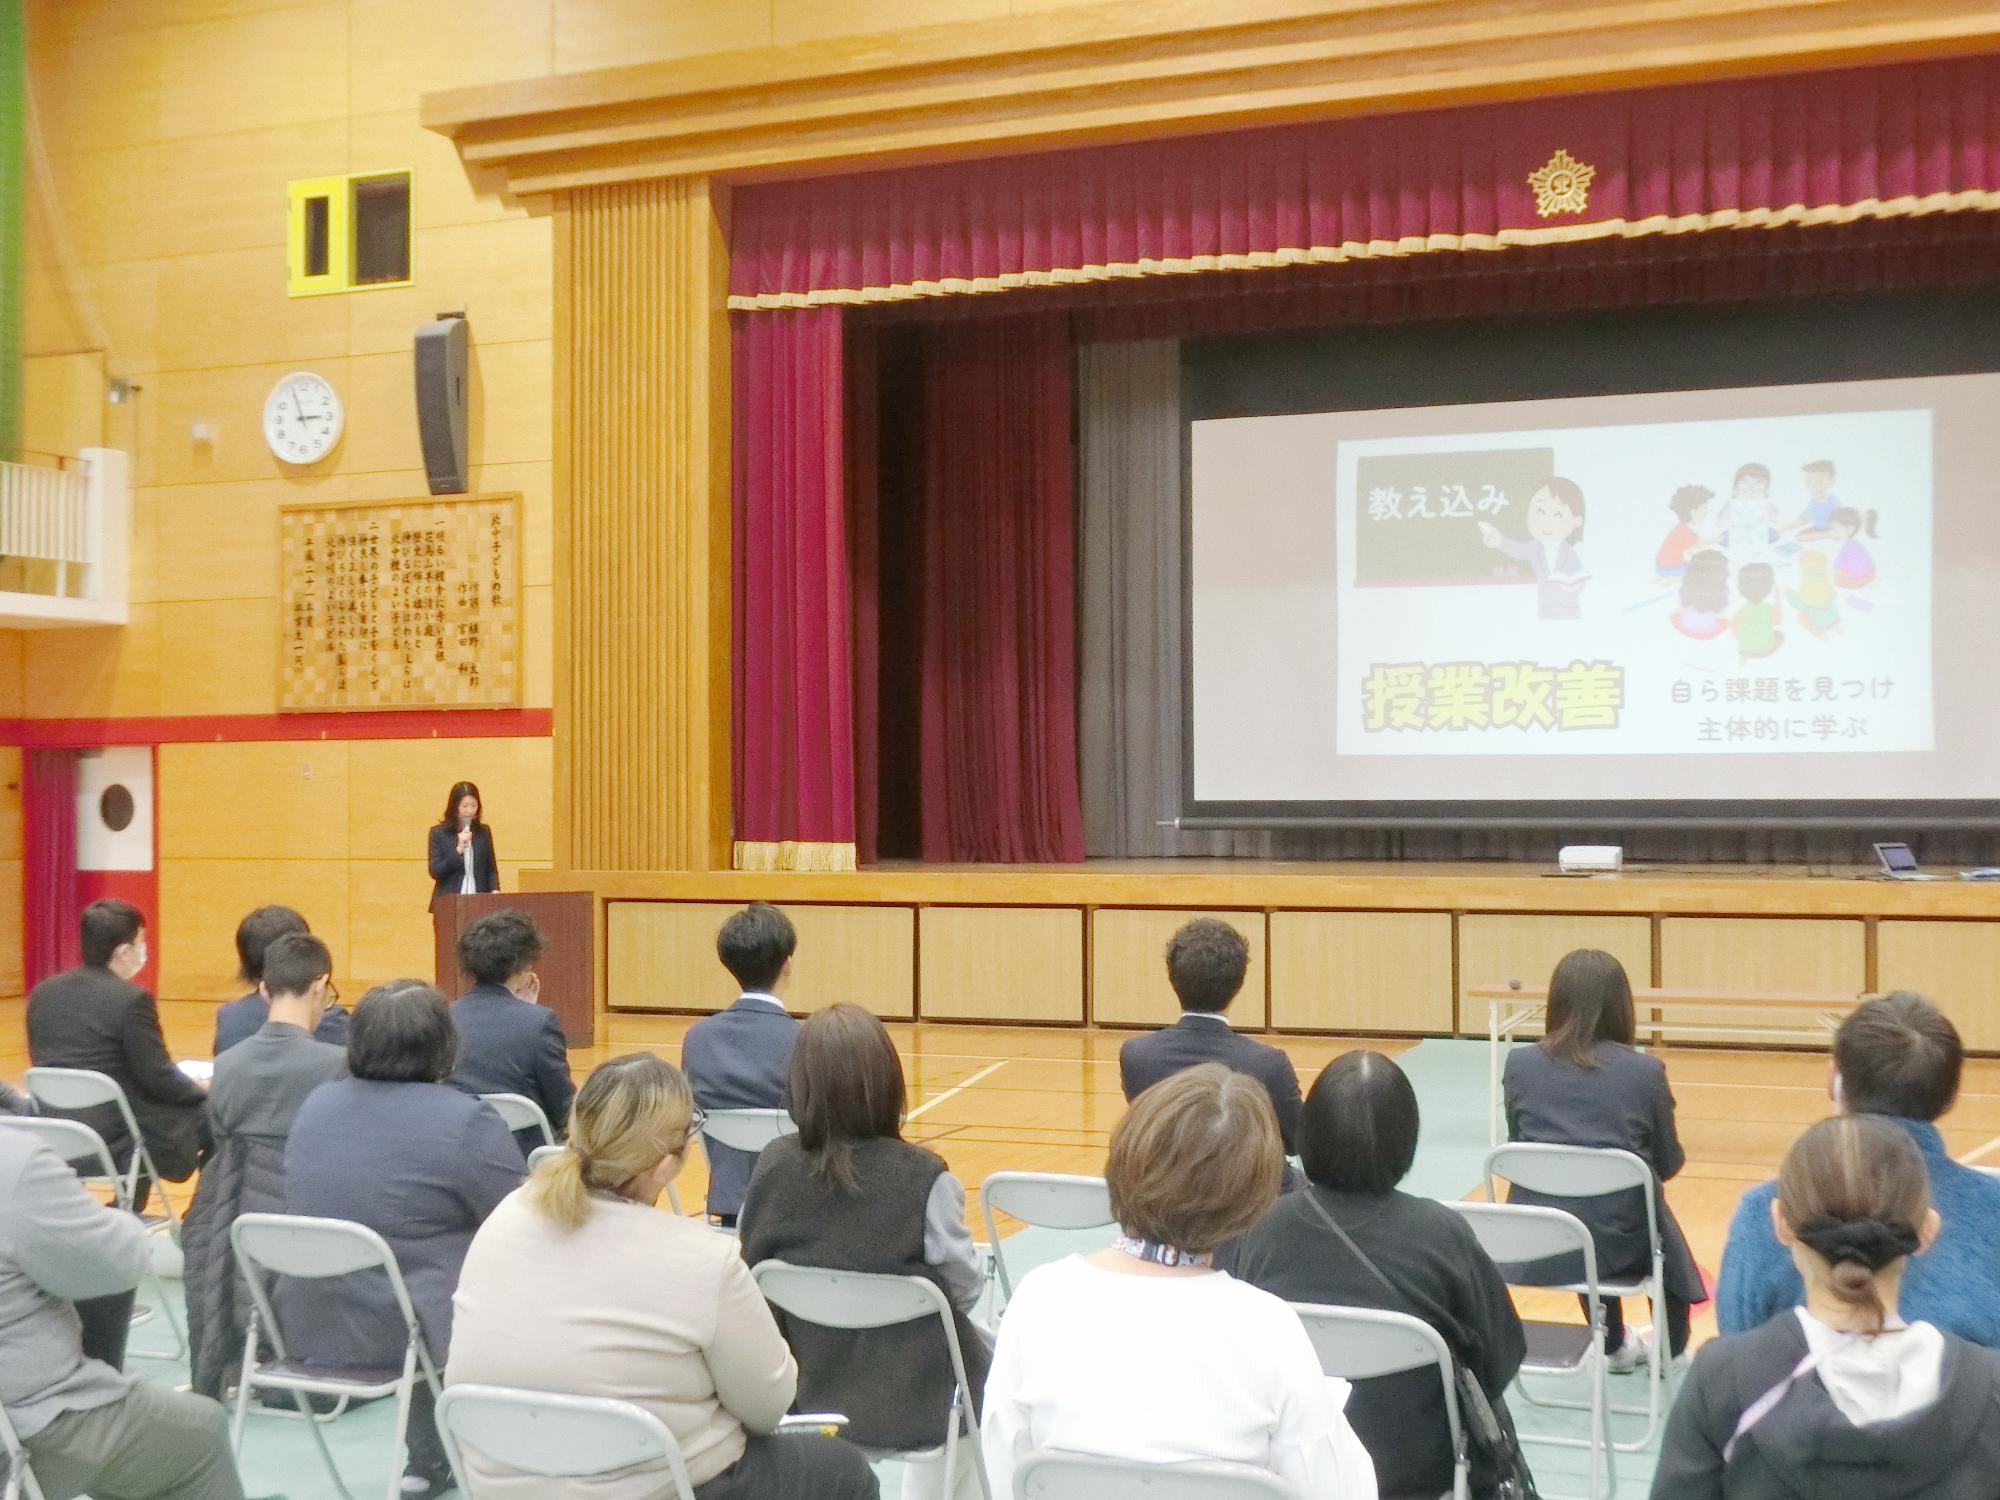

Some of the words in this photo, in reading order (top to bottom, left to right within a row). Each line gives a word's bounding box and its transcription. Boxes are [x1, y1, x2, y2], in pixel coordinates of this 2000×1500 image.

[1367, 483, 1510, 522] 教え込み
[1361, 659, 1626, 733] 授業改善
[1670, 675, 1896, 705] 自ら課題を見つけ
[1697, 716, 1868, 743] 主体的に学ぶ
